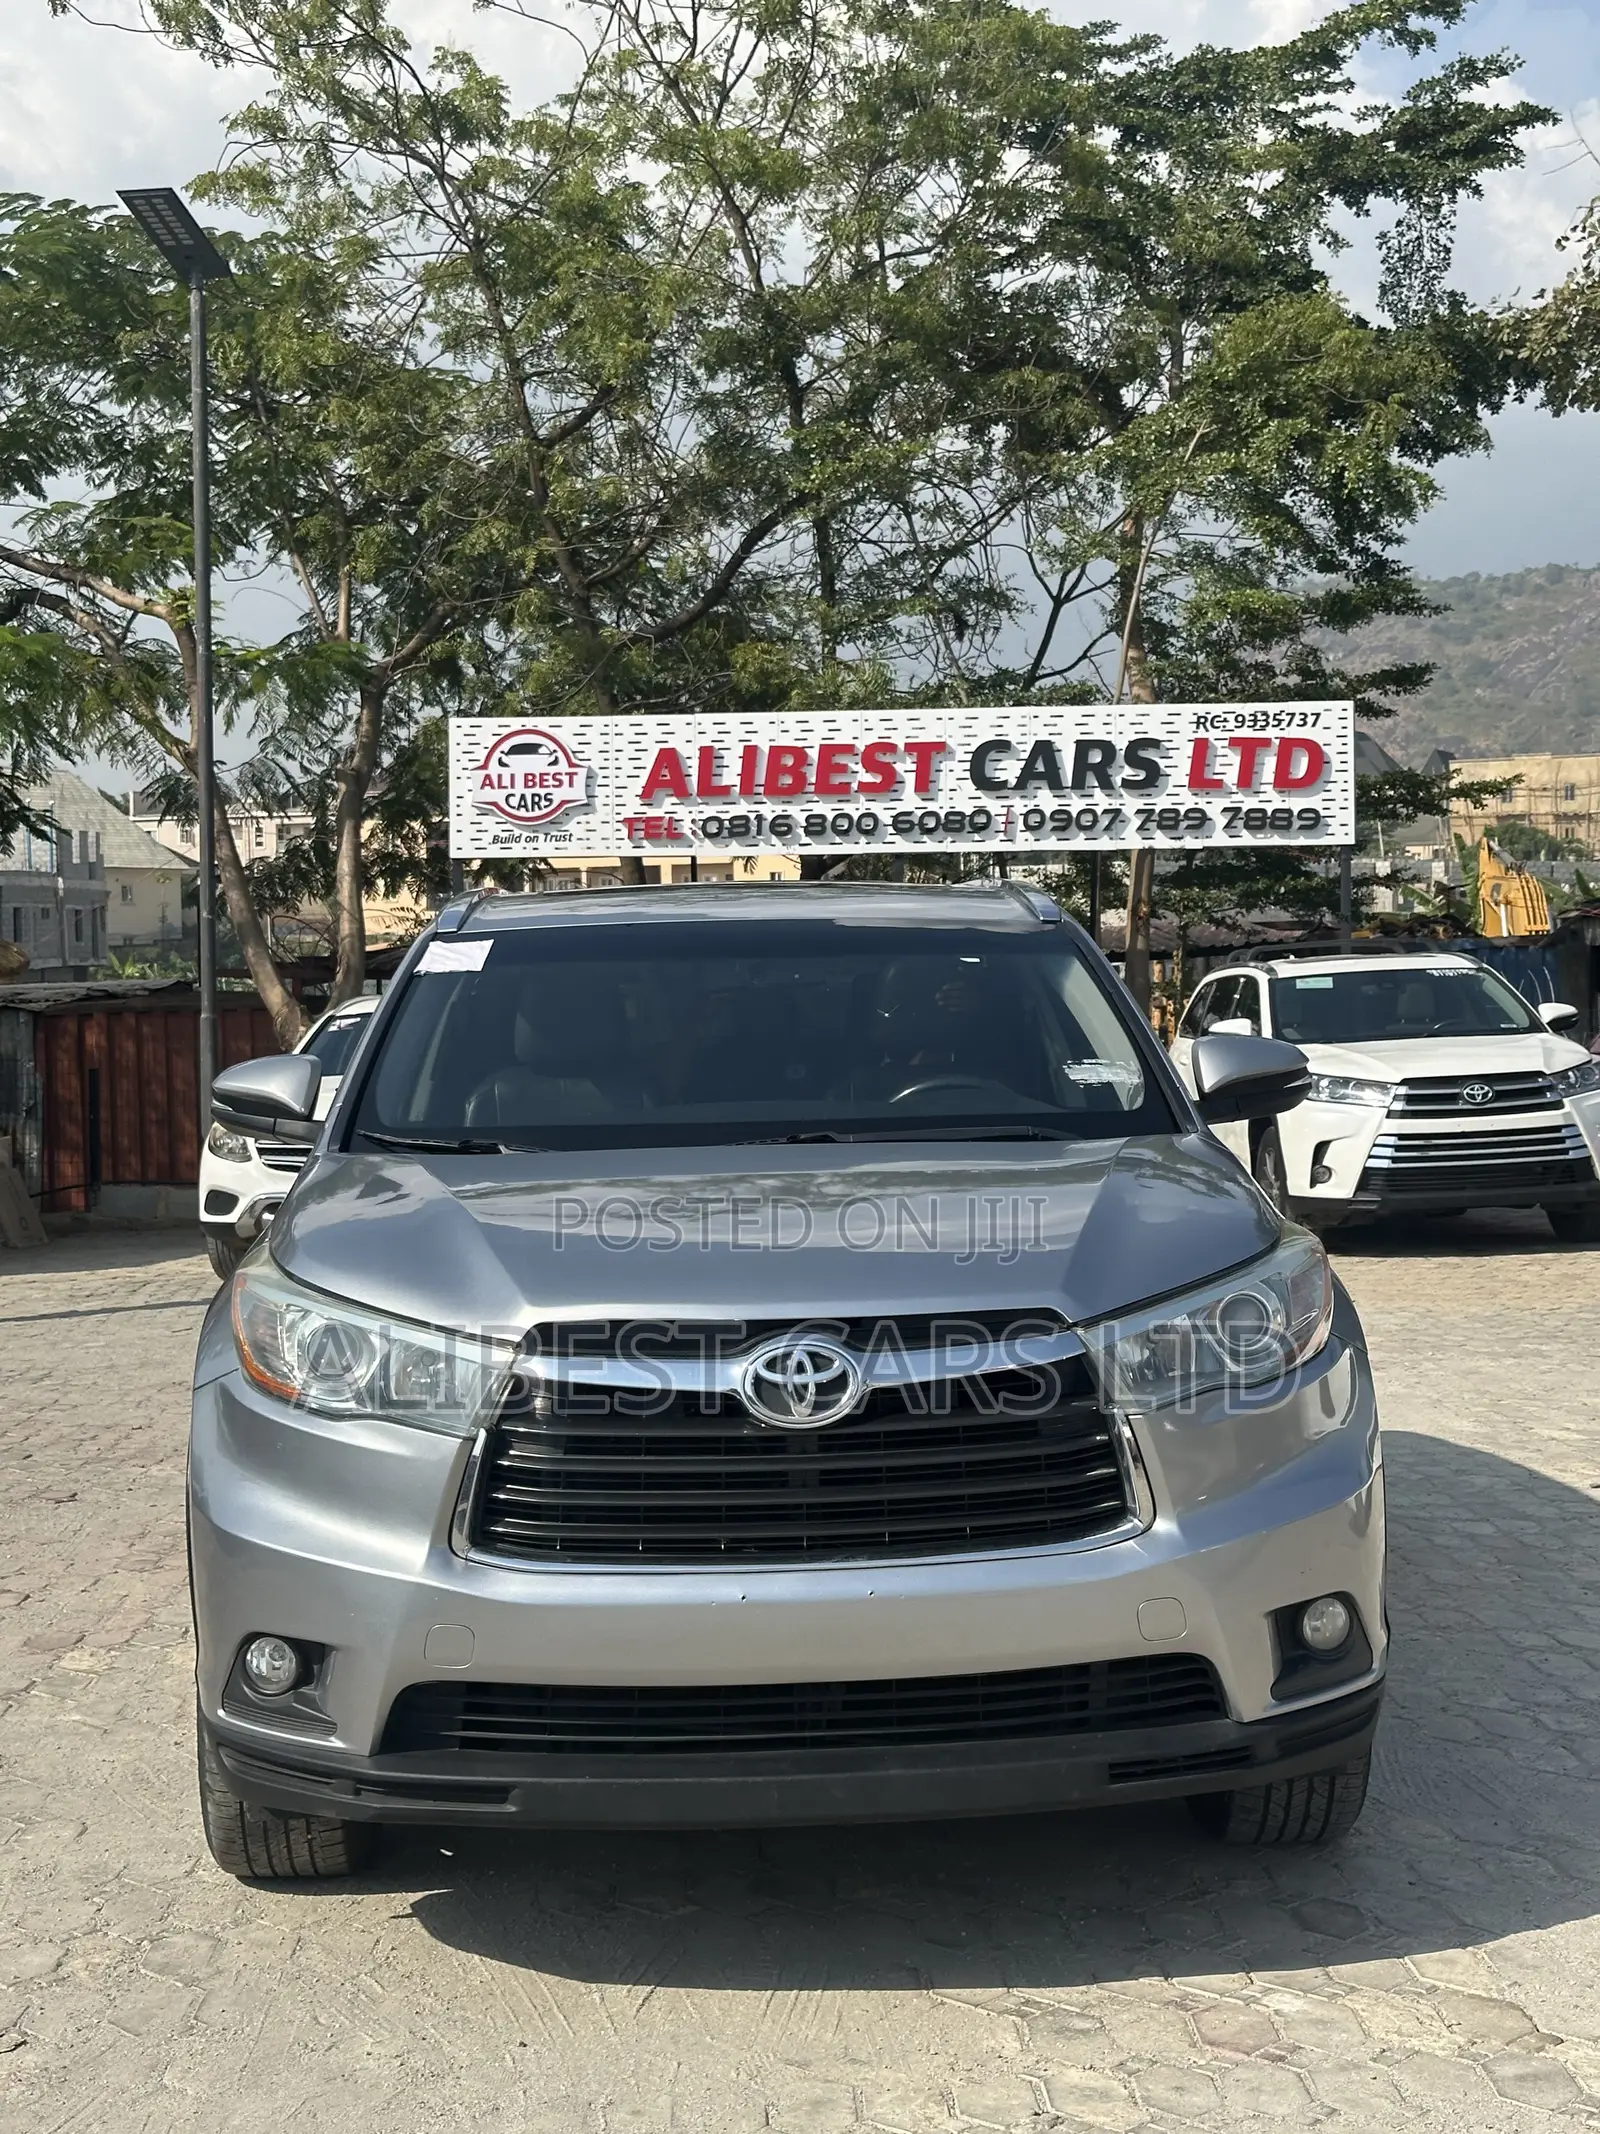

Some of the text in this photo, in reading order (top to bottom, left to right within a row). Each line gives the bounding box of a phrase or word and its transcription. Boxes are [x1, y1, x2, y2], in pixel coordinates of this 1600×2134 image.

[1233, 711, 1322, 729] 9335737
[640, 736, 1325, 801] ALIBEST CARS LTD
[480, 771, 578, 790] ALI BEST
[505, 792, 554, 812] CARS
[701, 813, 793, 839] 0816
[803, 812, 879, 836] 800
[892, 810, 993, 835] 6080
[1022, 808, 1124, 832] 0907
[1134, 807, 1208, 831] 789
[1221, 807, 1322, 831] 7889
[491, 832, 574, 844] Build on Trust
